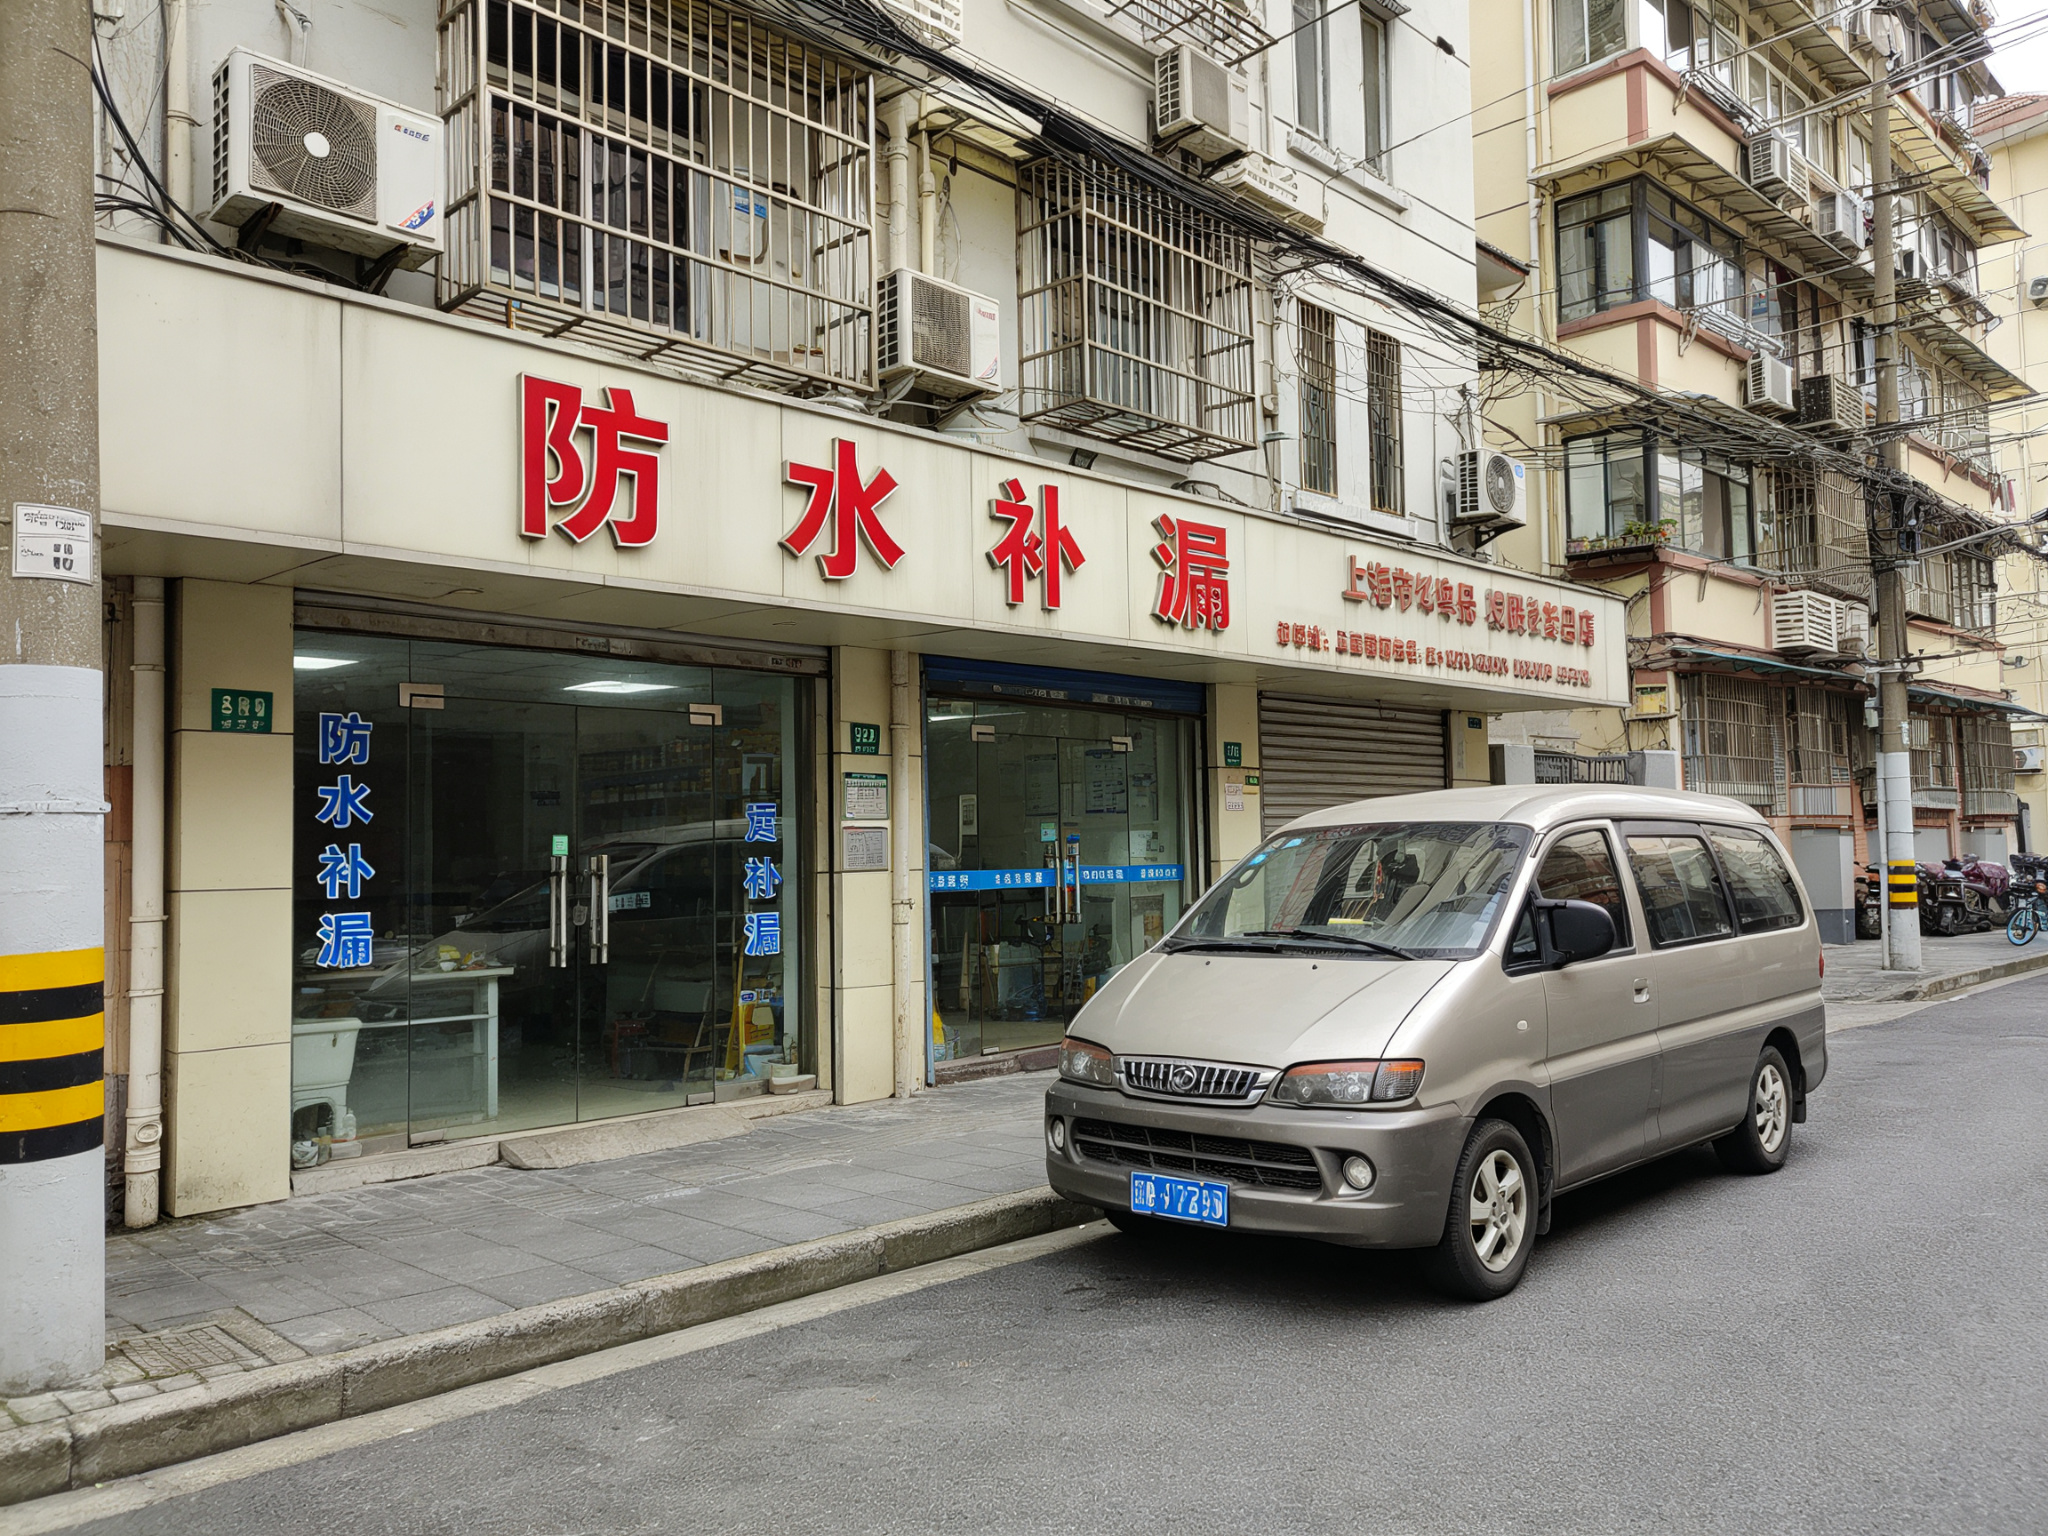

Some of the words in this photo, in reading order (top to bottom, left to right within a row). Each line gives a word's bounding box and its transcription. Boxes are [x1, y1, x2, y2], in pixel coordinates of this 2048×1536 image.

[518, 371, 1230, 632] 防水补漏
[314, 711, 376, 969] 防水补漏
